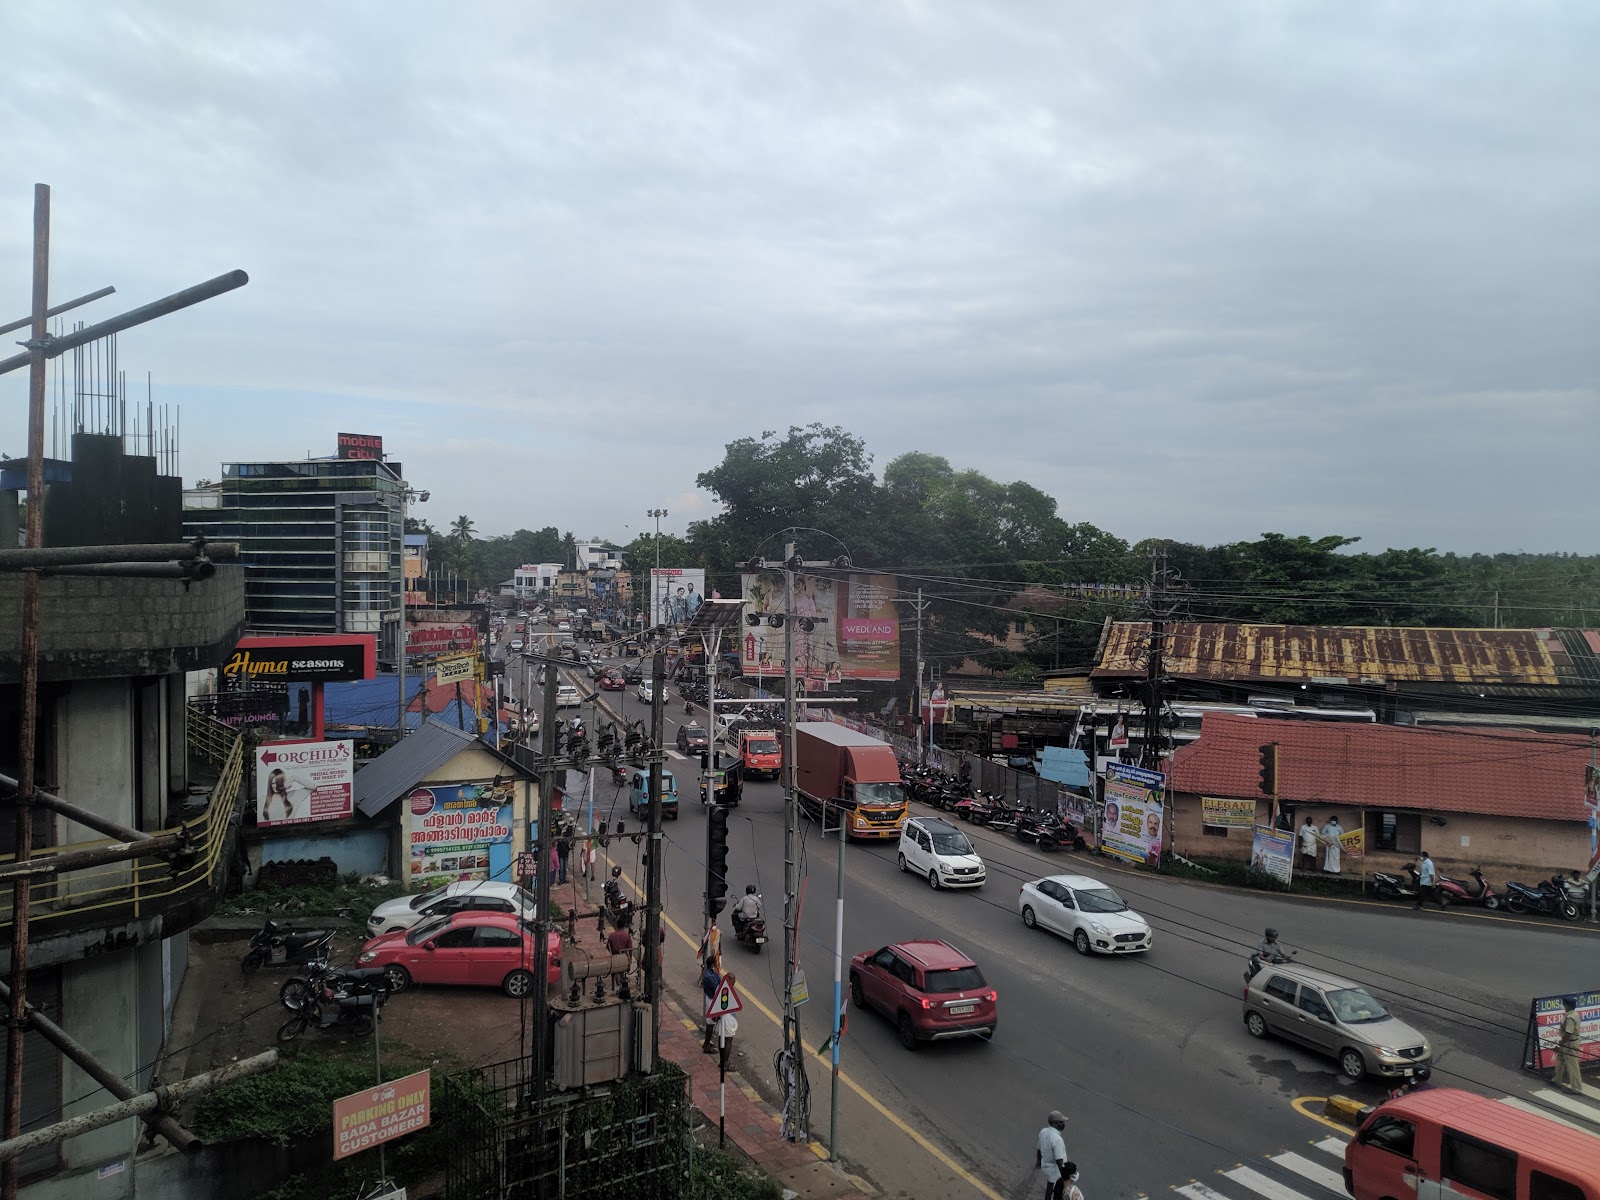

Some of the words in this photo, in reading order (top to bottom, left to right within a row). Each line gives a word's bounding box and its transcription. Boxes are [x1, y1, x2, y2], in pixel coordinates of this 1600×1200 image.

[338, 436, 382, 448] mobile
[846, 626, 892, 634] WEDLAND
[224, 651, 289, 678] Hyma
[292, 660, 344, 668] seasons
[244, 713, 276, 723] LOUNGE
[1204, 800, 1254, 810] ELEGANT
[1541, 1000, 1560, 1010] LIONS
[1546, 1014, 1564, 1024] KER
[342, 1100, 396, 1130] PARKING
[398, 1089, 426, 1108] ONLY
[340, 1122, 376, 1142] BADA
[381, 1104, 425, 1126] BAZAR
[340, 1116, 424, 1153] CUSTOMERS
